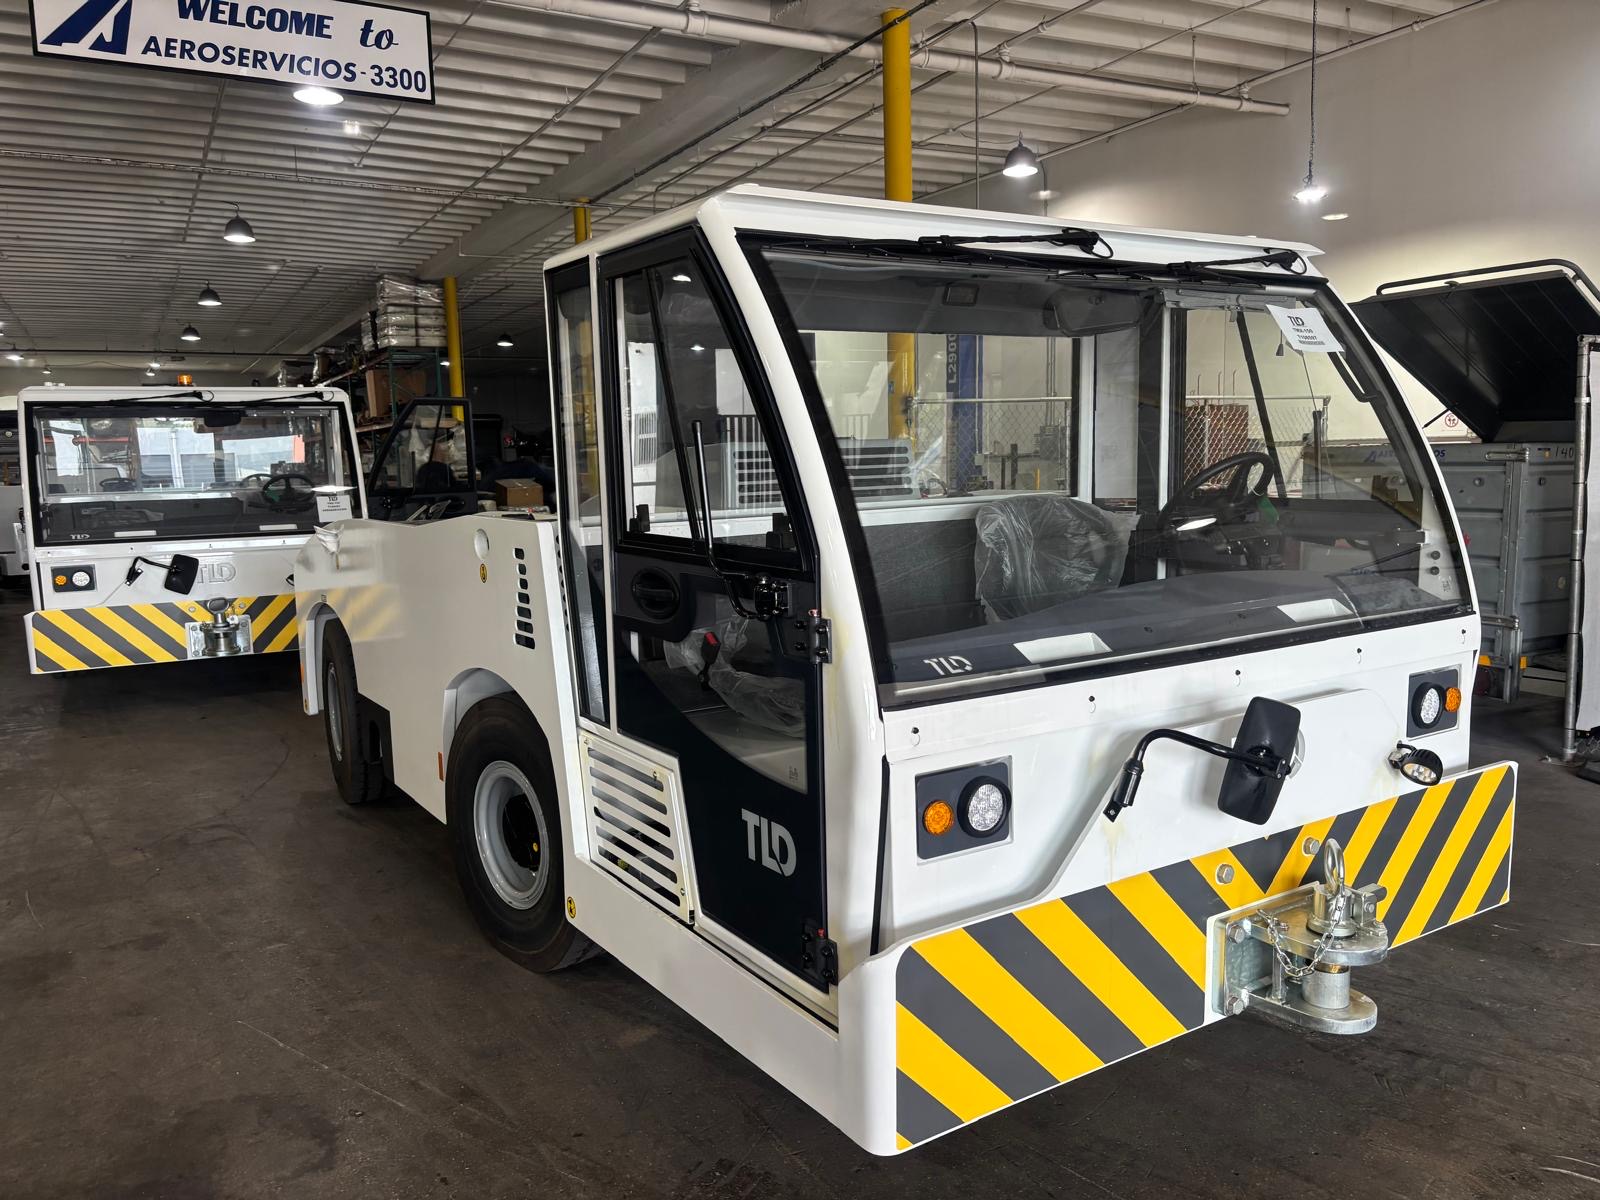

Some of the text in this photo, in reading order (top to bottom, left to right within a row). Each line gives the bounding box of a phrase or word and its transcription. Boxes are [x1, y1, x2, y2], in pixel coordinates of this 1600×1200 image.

[177, 0, 399, 50] WELCOME to
[141, 35, 427, 93] AEROSERVICIOS-3300
[923, 655, 973, 675] TLD
[741, 807, 797, 877] TLD
